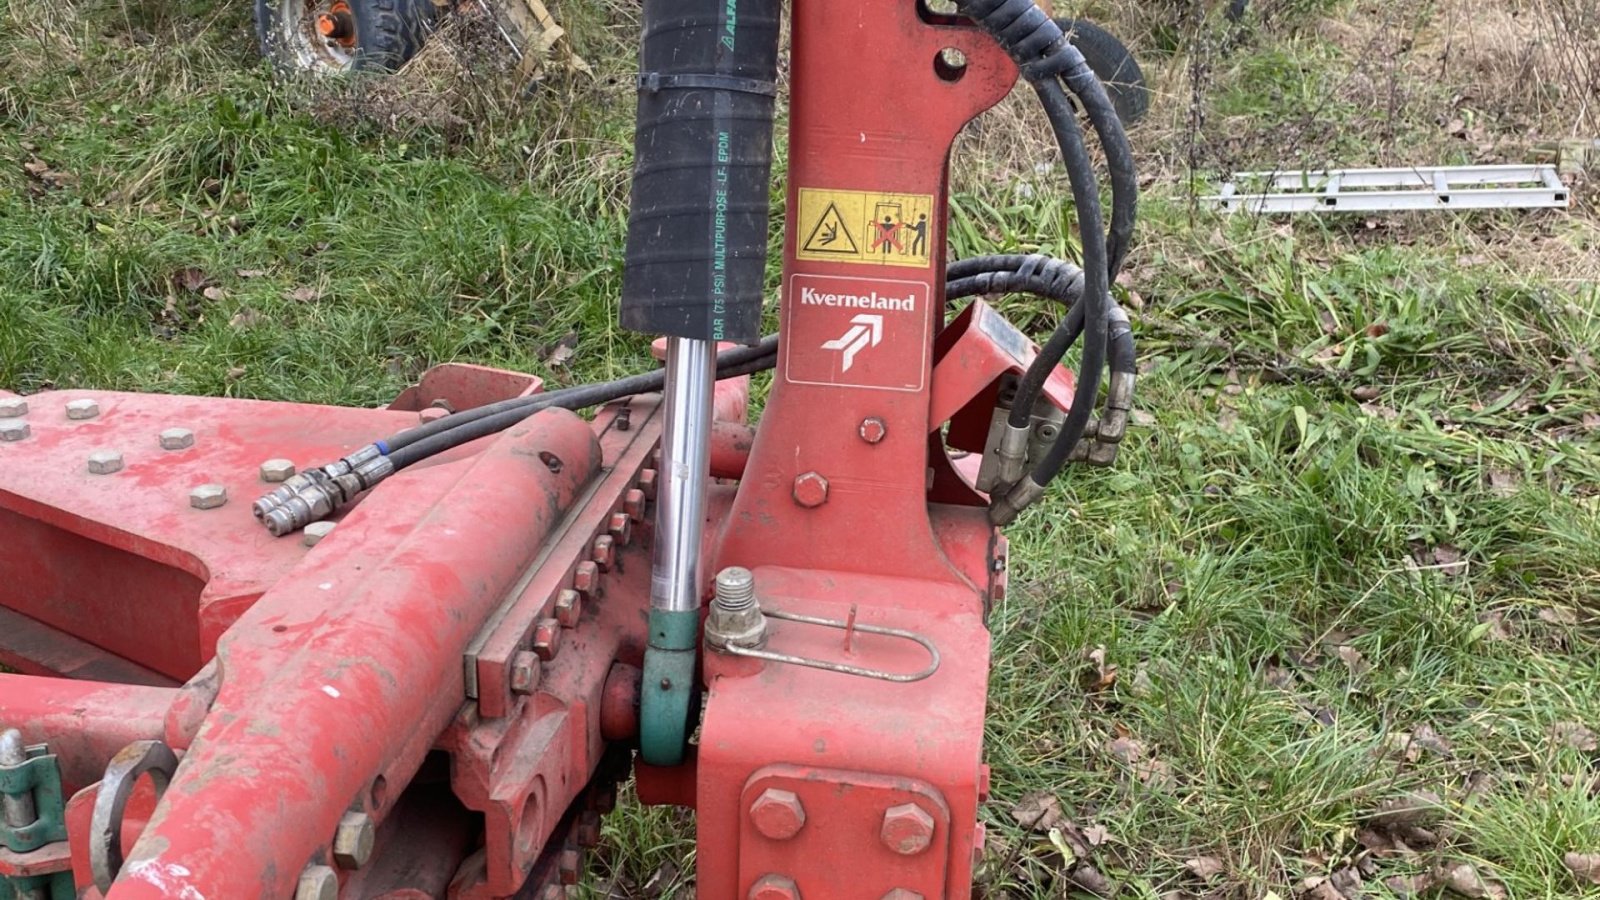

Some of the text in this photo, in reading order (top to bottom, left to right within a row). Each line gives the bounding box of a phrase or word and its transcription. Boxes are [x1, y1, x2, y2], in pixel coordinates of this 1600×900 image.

[717, 131, 730, 163] EPDM
[714, 190, 727, 270] MULTIPURPOSE
[713, 274, 726, 295] PSI)
[713, 298, 726, 314] (75
[801, 287, 915, 312] Kverneland
[713, 318, 725, 340] BAR
